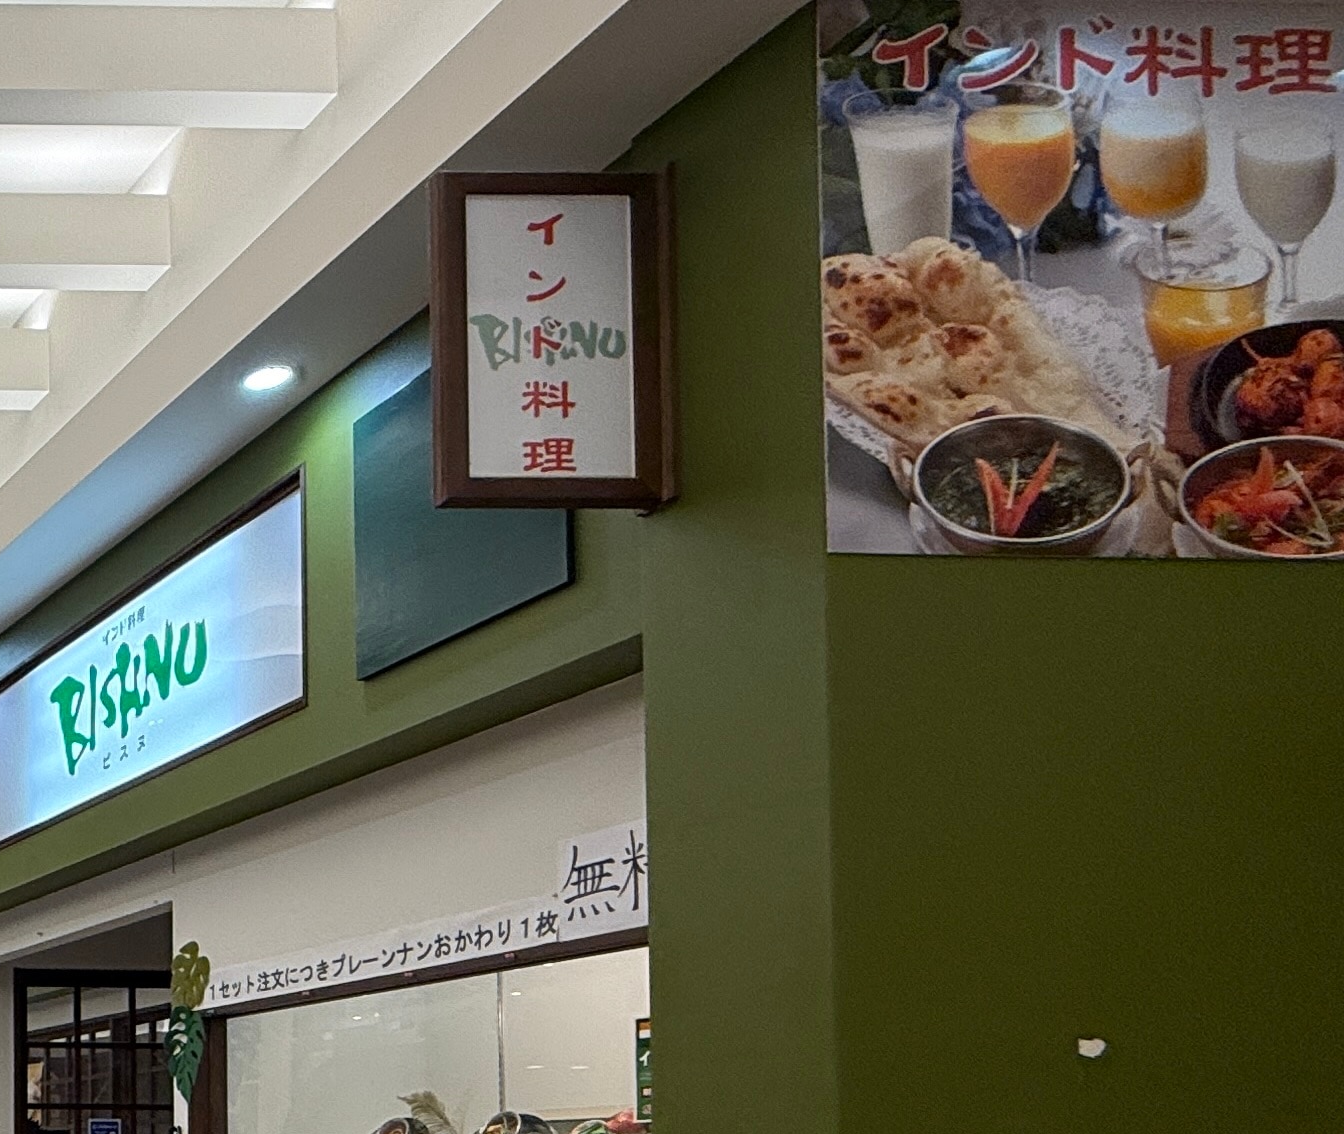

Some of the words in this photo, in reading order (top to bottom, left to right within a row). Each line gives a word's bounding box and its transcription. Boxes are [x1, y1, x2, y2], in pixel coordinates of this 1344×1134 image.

[873, 15, 1339, 96] インド料理
[522, 213, 577, 473] インド料理
[102, 605, 146, 646] インド料理
[50, 619, 208, 776] BISHNU
[102, 734, 147, 770] ビスヌ
